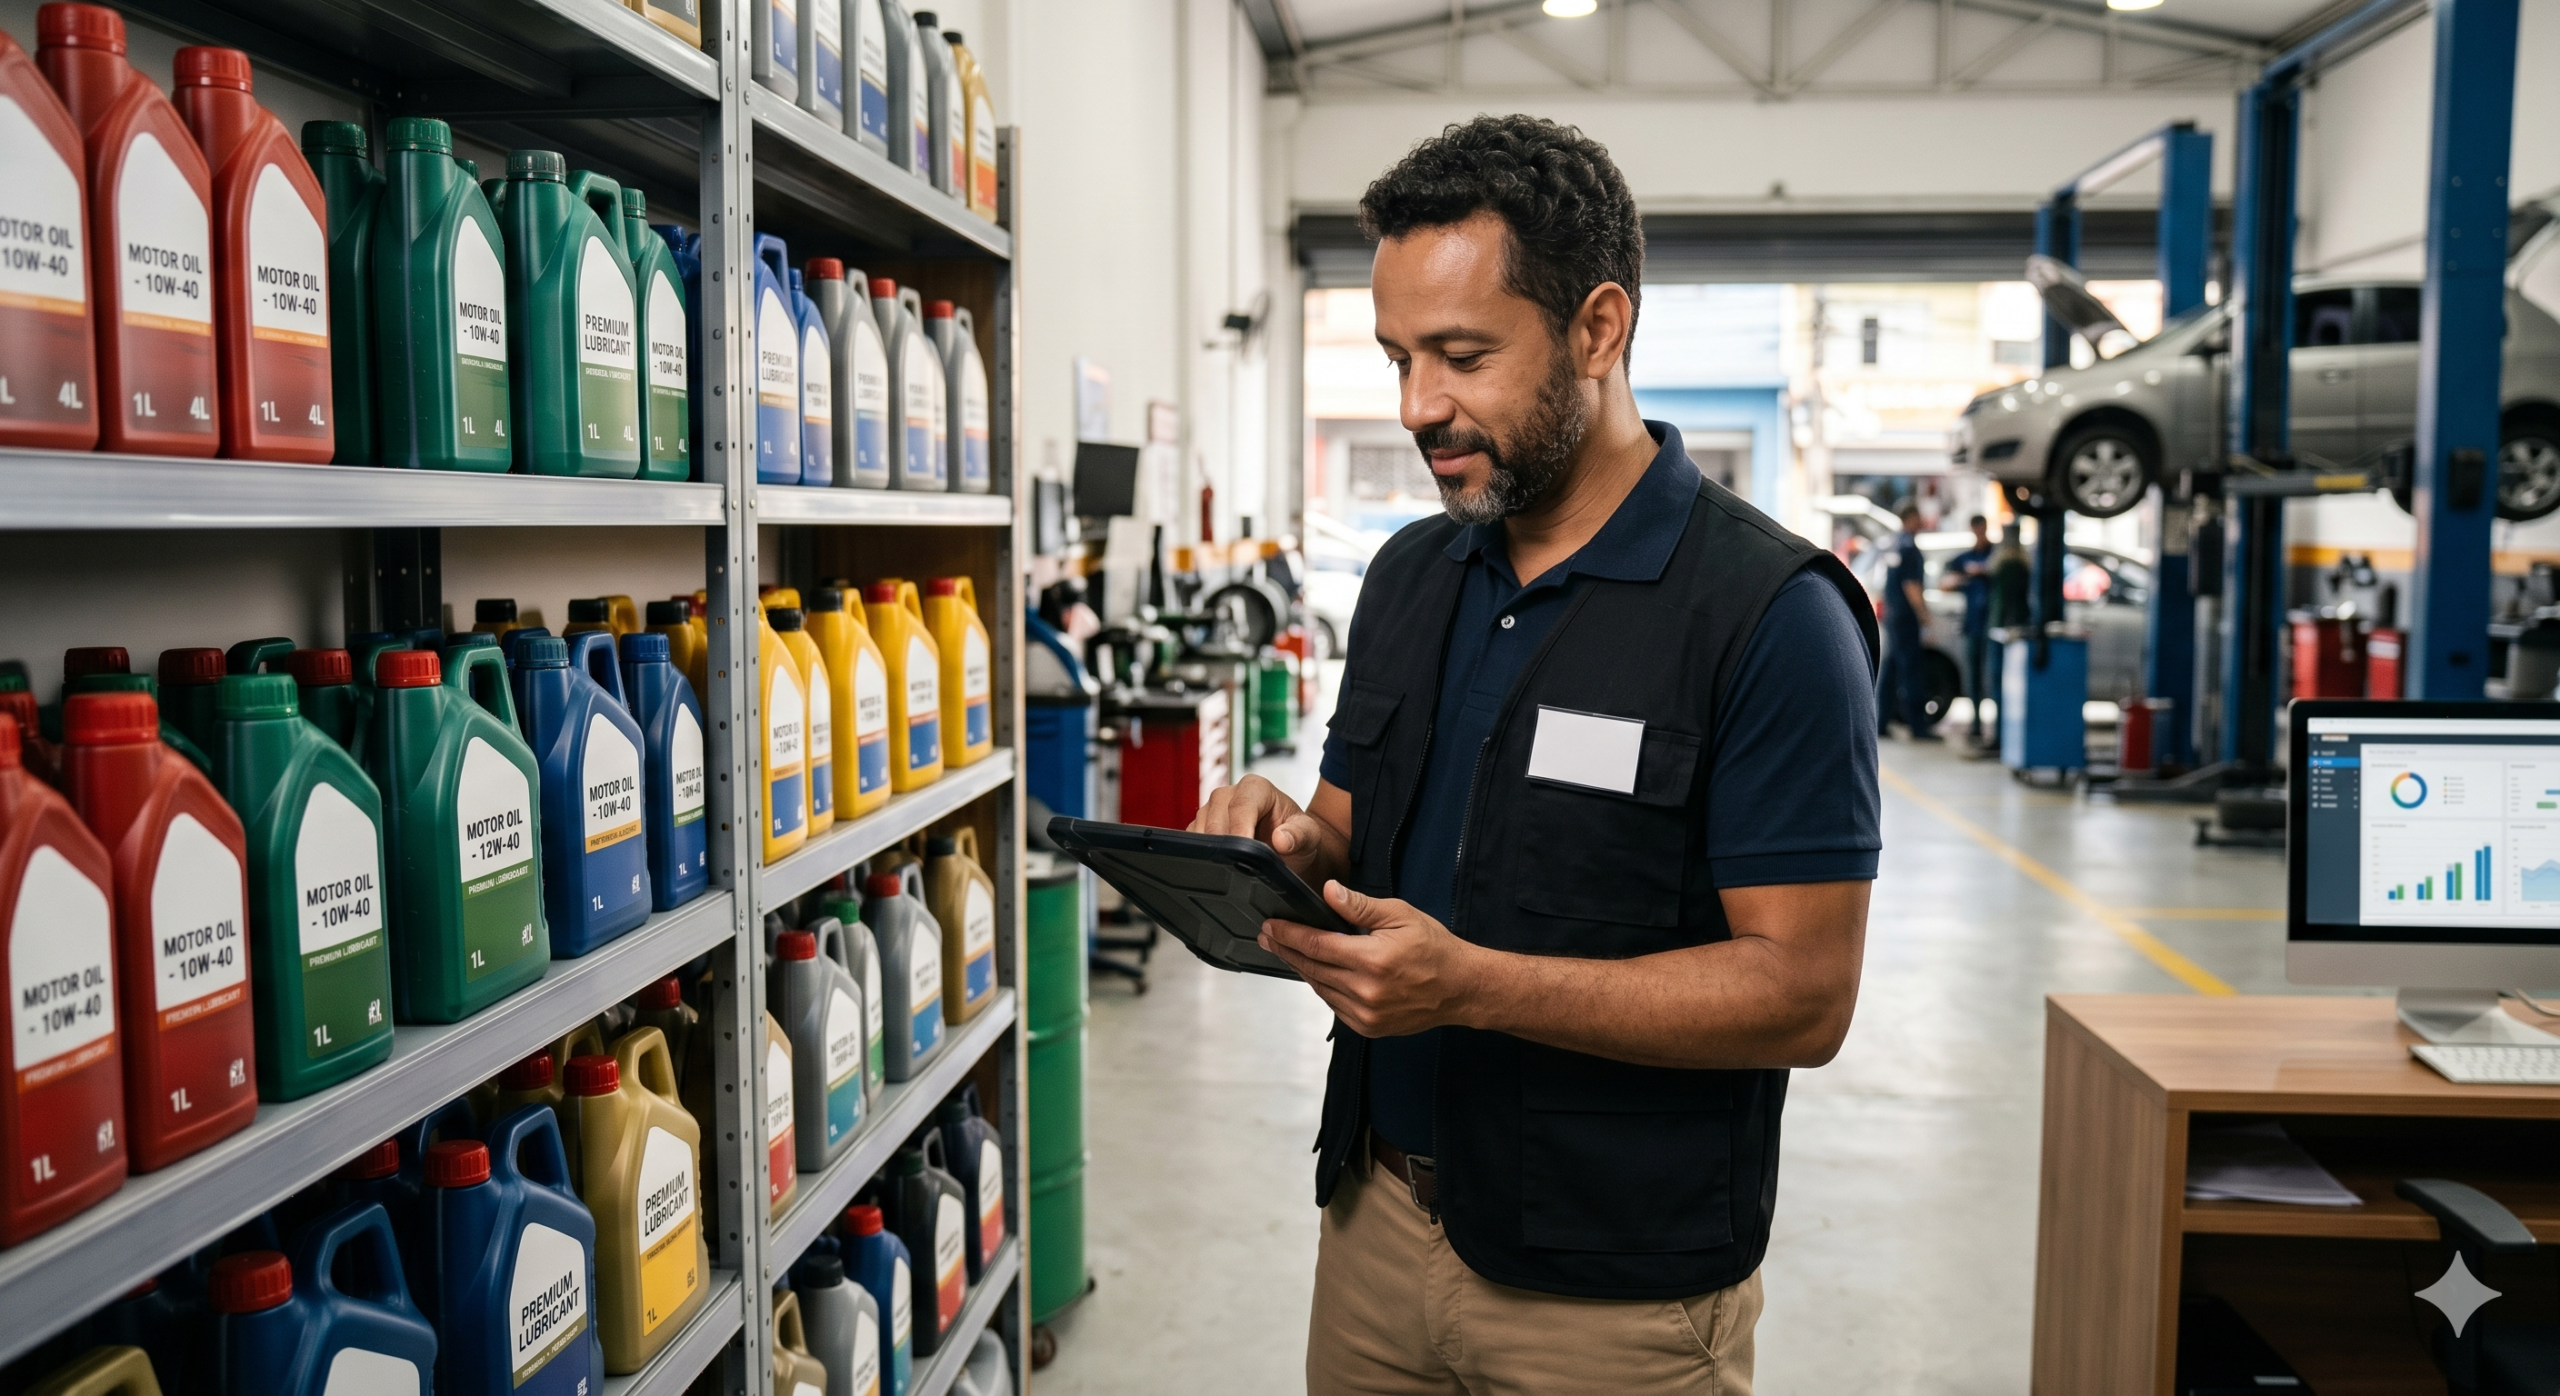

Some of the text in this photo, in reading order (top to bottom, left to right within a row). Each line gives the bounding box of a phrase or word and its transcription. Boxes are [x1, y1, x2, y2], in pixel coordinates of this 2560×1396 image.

[49, 226, 74, 250] OIL
[3, 248, 69, 277] 10W-40
[128, 243, 203, 275] MOTOR OIL
[146, 273, 199, 300] 10W-40
[257, 265, 320, 293] MOTOR OIL
[271, 293, 317, 316] 10W-40
[459, 302, 502, 326] MOTOR OIL
[469, 325, 500, 345] 10W-40
[585, 314, 629, 338] PREMIUM
[584, 336, 631, 358] LUBRICANT
[652, 341, 673, 358] MOTOR
[0, 376, 15, 405] L
[59, 381, 83, 409] 4L
[133, 392, 156, 417] 1L
[190, 396, 210, 420] 4L
[260, 401, 281, 422] 1L
[309, 404, 325, 425] 4L
[462, 416, 476, 435] 1L
[494, 419, 506, 437] 4L
[588, 422, 600, 440] 1L
[623, 425, 634, 442] 4L
[654, 436, 664, 451] 1L
[589, 776, 634, 802] MOTOR OIL
[598, 796, 631, 820] 10W-40
[466, 809, 523, 841] MOTOR OIL
[479, 832, 520, 860] 12W-40
[679, 863, 687, 875] 1L
[307, 873, 373, 908] MOTOR OIL
[321, 897, 370, 929] 10W-40
[592, 895, 604, 911] 1L
[164, 920, 236, 957] MOTOR OIL
[179, 946, 233, 981] 10W-40
[471, 950, 485, 969] 1L
[23, 965, 105, 1010] MOTOR OIL
[42, 994, 102, 1035] 10W-40
[313, 1024, 331, 1047] 1L
[170, 1088, 191, 1112] 1L
[31, 1155, 56, 1183] 1L
[645, 1171, 685, 1216] PREMIUM
[644, 1186, 689, 1238] LUBRICANT
[521, 1270, 573, 1327] PREMIUM
[519, 1287, 580, 1353] LUBRICANT
[647, 1307, 658, 1325] 1L
